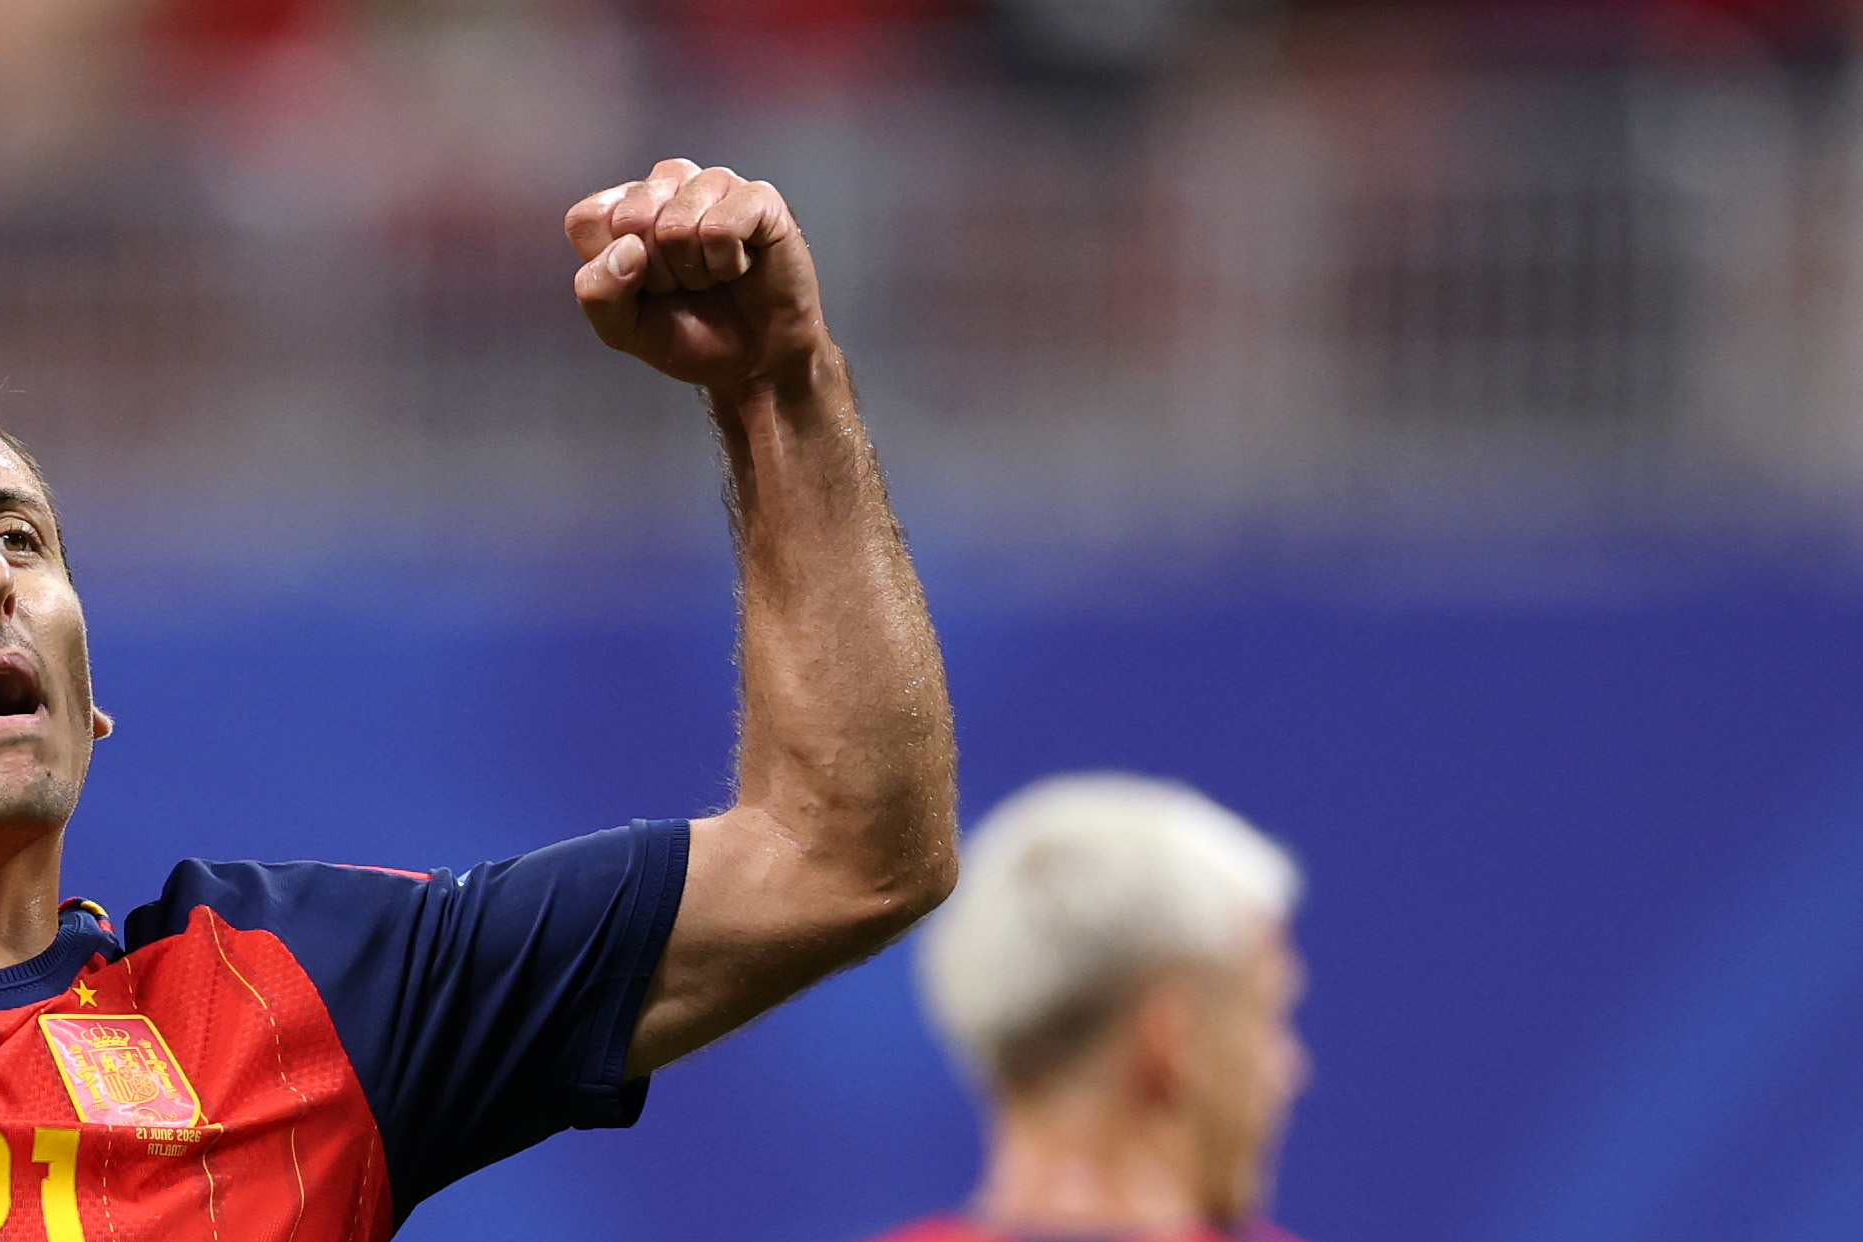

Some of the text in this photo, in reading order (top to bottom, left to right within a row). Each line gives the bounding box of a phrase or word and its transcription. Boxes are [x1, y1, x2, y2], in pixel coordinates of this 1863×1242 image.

[135, 1127, 202, 1143] 21 JUNE 2026
